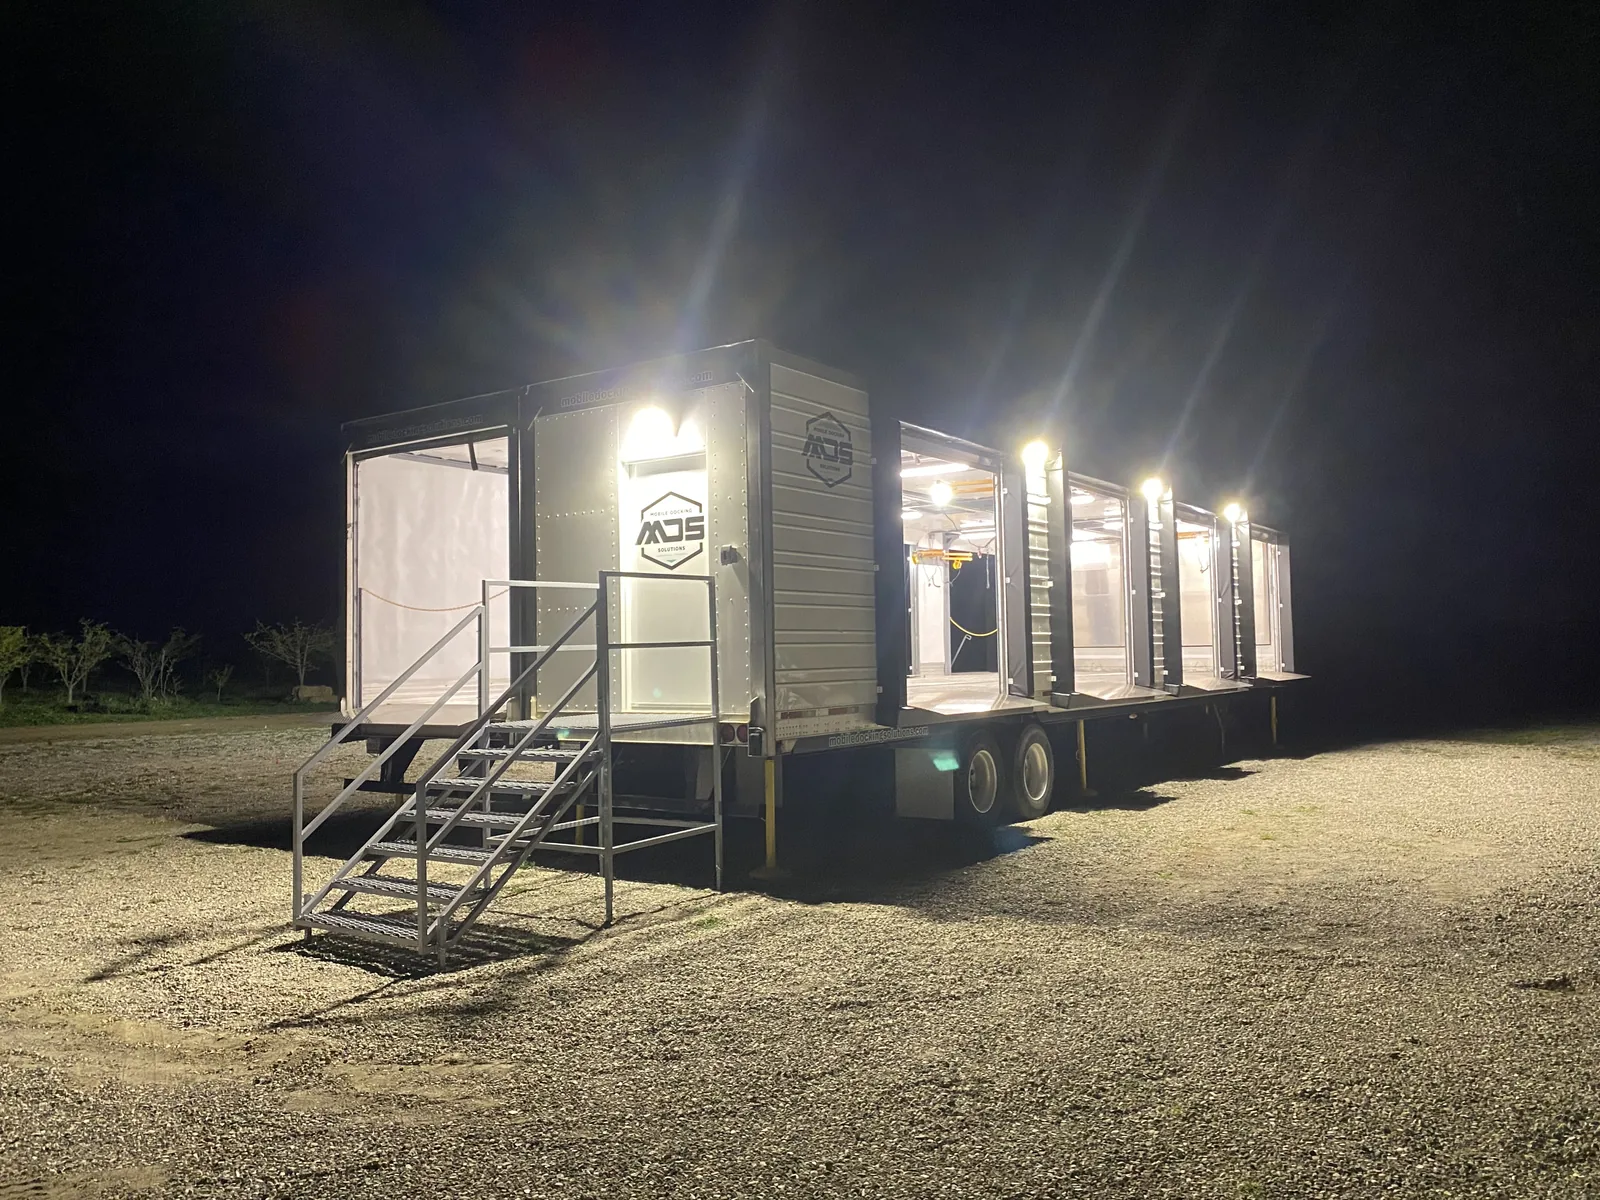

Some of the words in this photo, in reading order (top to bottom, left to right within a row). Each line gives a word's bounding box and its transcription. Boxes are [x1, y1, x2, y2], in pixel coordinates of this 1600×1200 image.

[801, 433, 853, 466] MDS
[635, 515, 705, 546] MDS
[829, 726, 929, 747] mobiledockingsolutions.com
